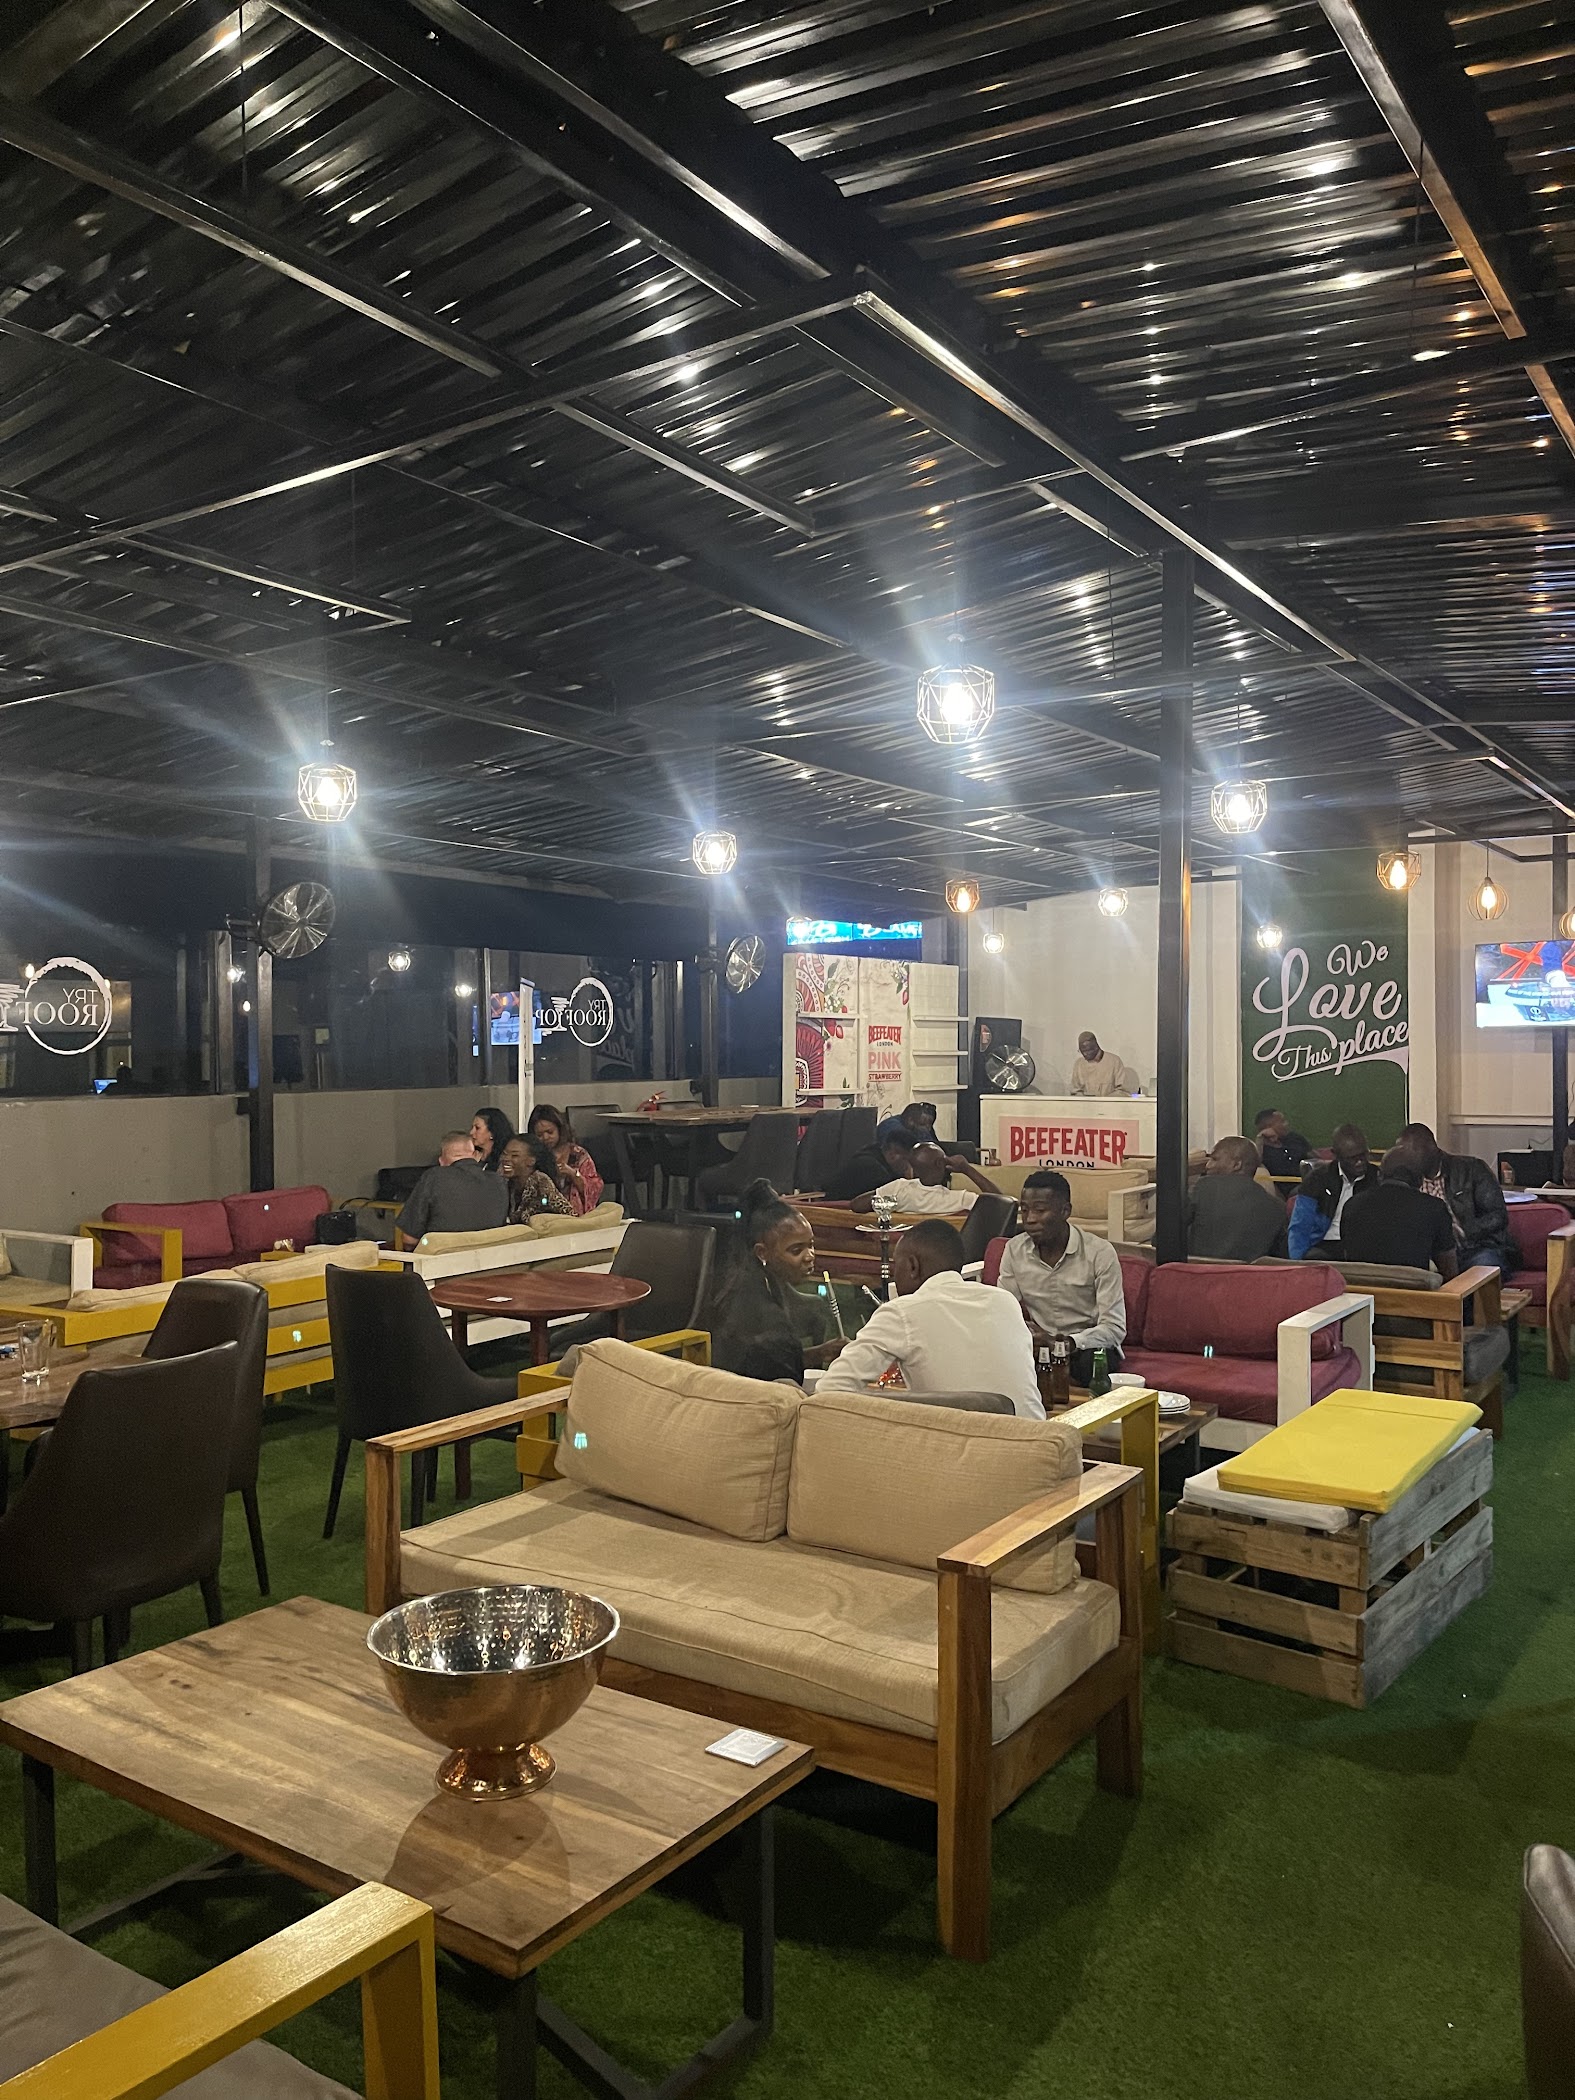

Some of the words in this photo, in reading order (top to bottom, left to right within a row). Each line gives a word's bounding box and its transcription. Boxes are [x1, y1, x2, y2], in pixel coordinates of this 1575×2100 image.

[1326, 940, 1389, 976] We
[1252, 947, 1402, 1062] Love
[868, 1025, 902, 1045] BEEFEATER
[1271, 1044, 1333, 1080] This
[1335, 1020, 1409, 1075] place
[868, 1051, 902, 1070] PINK
[868, 1073, 902, 1081] STRAWBERRY
[1010, 1126, 1126, 1167] BEEFEATER
